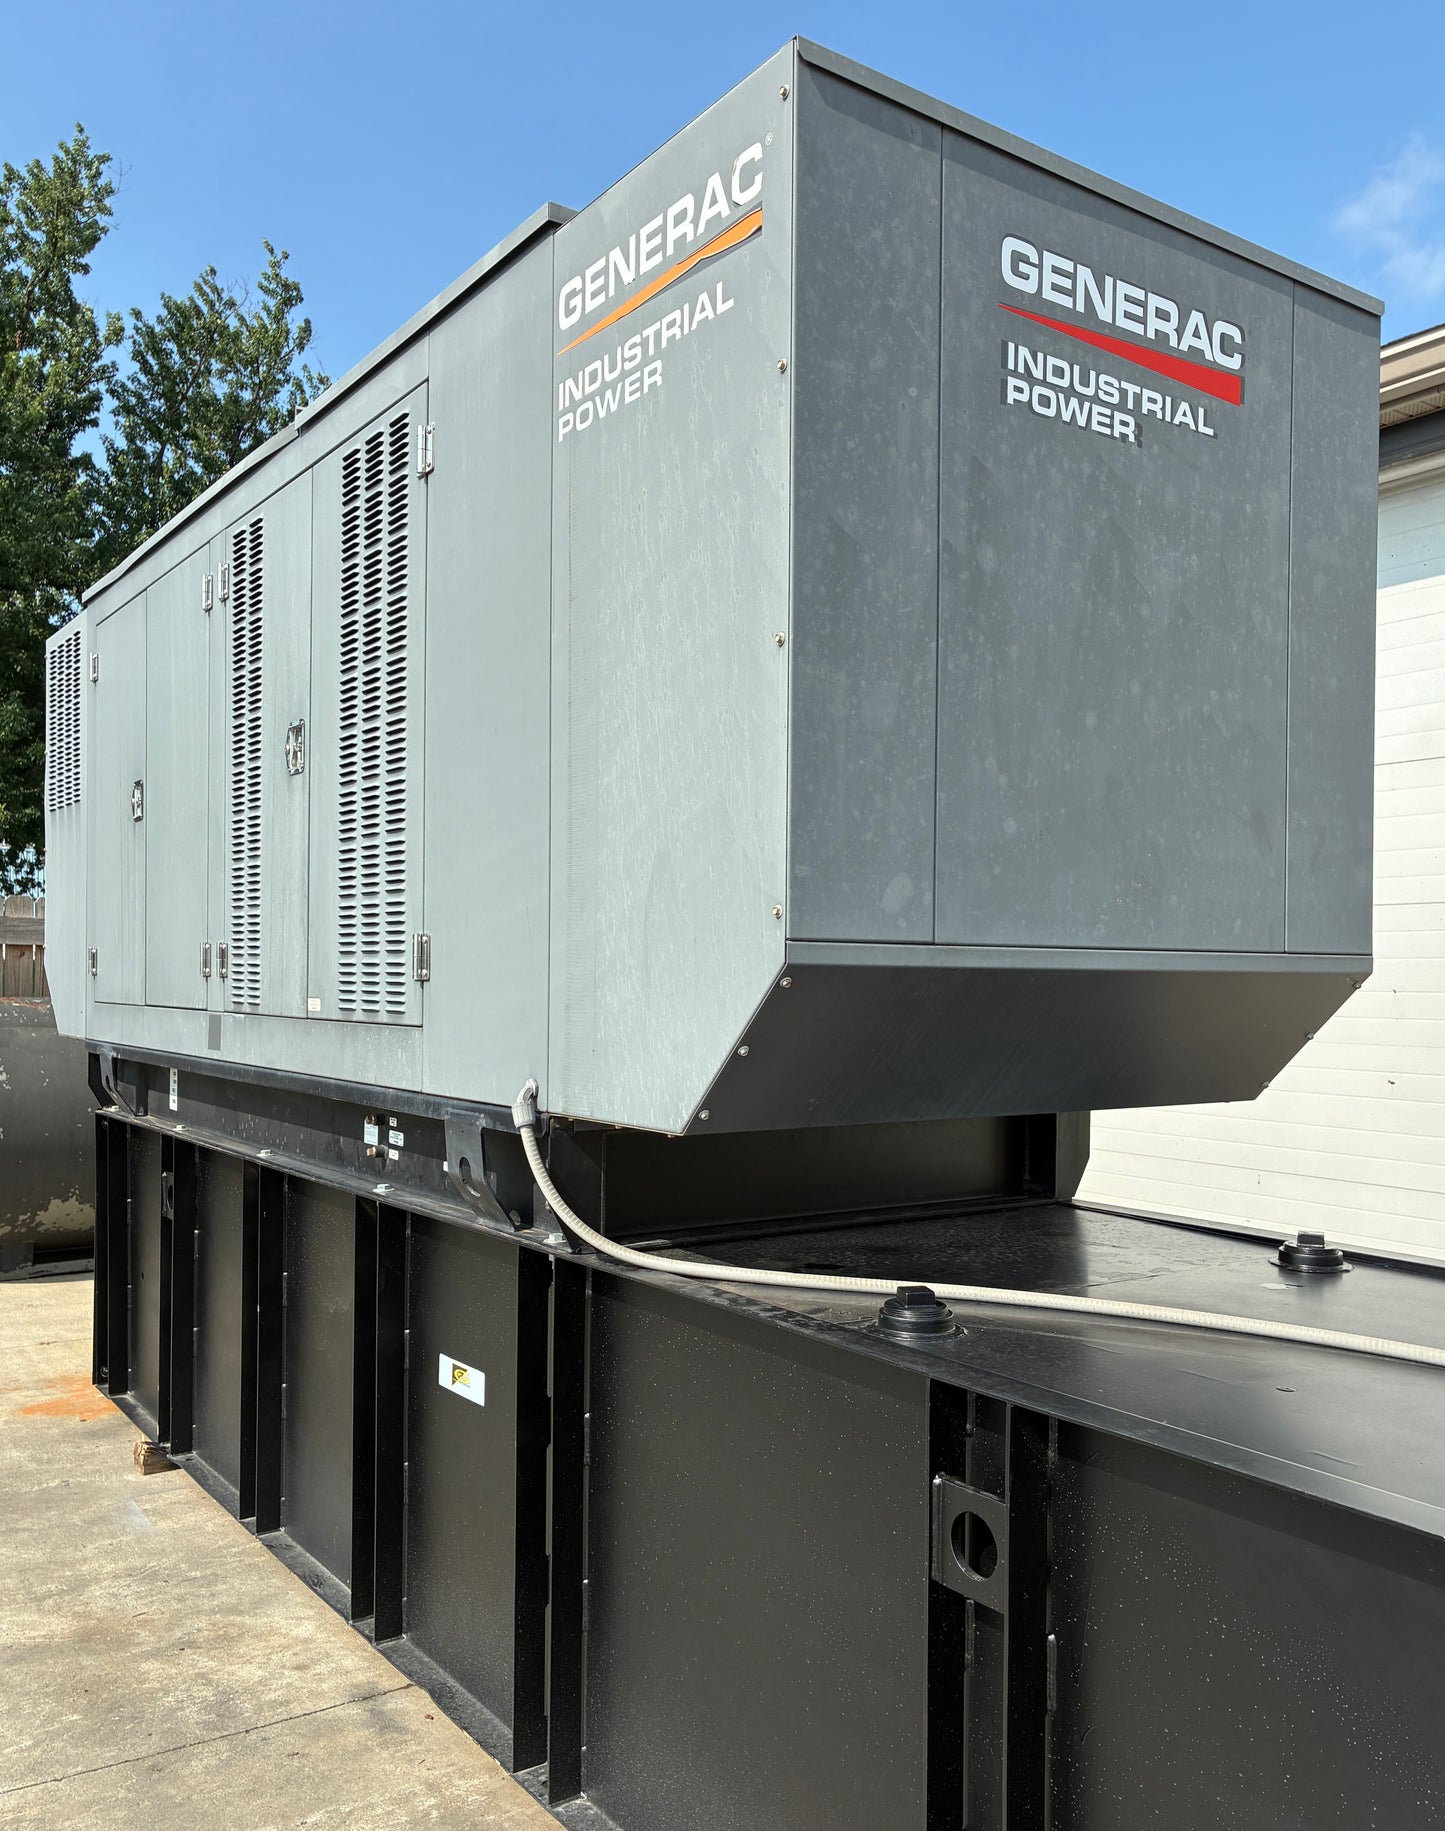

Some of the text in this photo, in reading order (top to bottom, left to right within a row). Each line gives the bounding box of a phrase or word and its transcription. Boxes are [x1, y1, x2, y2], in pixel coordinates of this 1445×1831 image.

[558, 280, 735, 412] INDUSTRIAL
[1001, 236, 1242, 370] GENERAC
[558, 359, 663, 443] POWER
[1006, 375, 1136, 443] POWER
[1007, 341, 1214, 436] INDUSTRIAL
